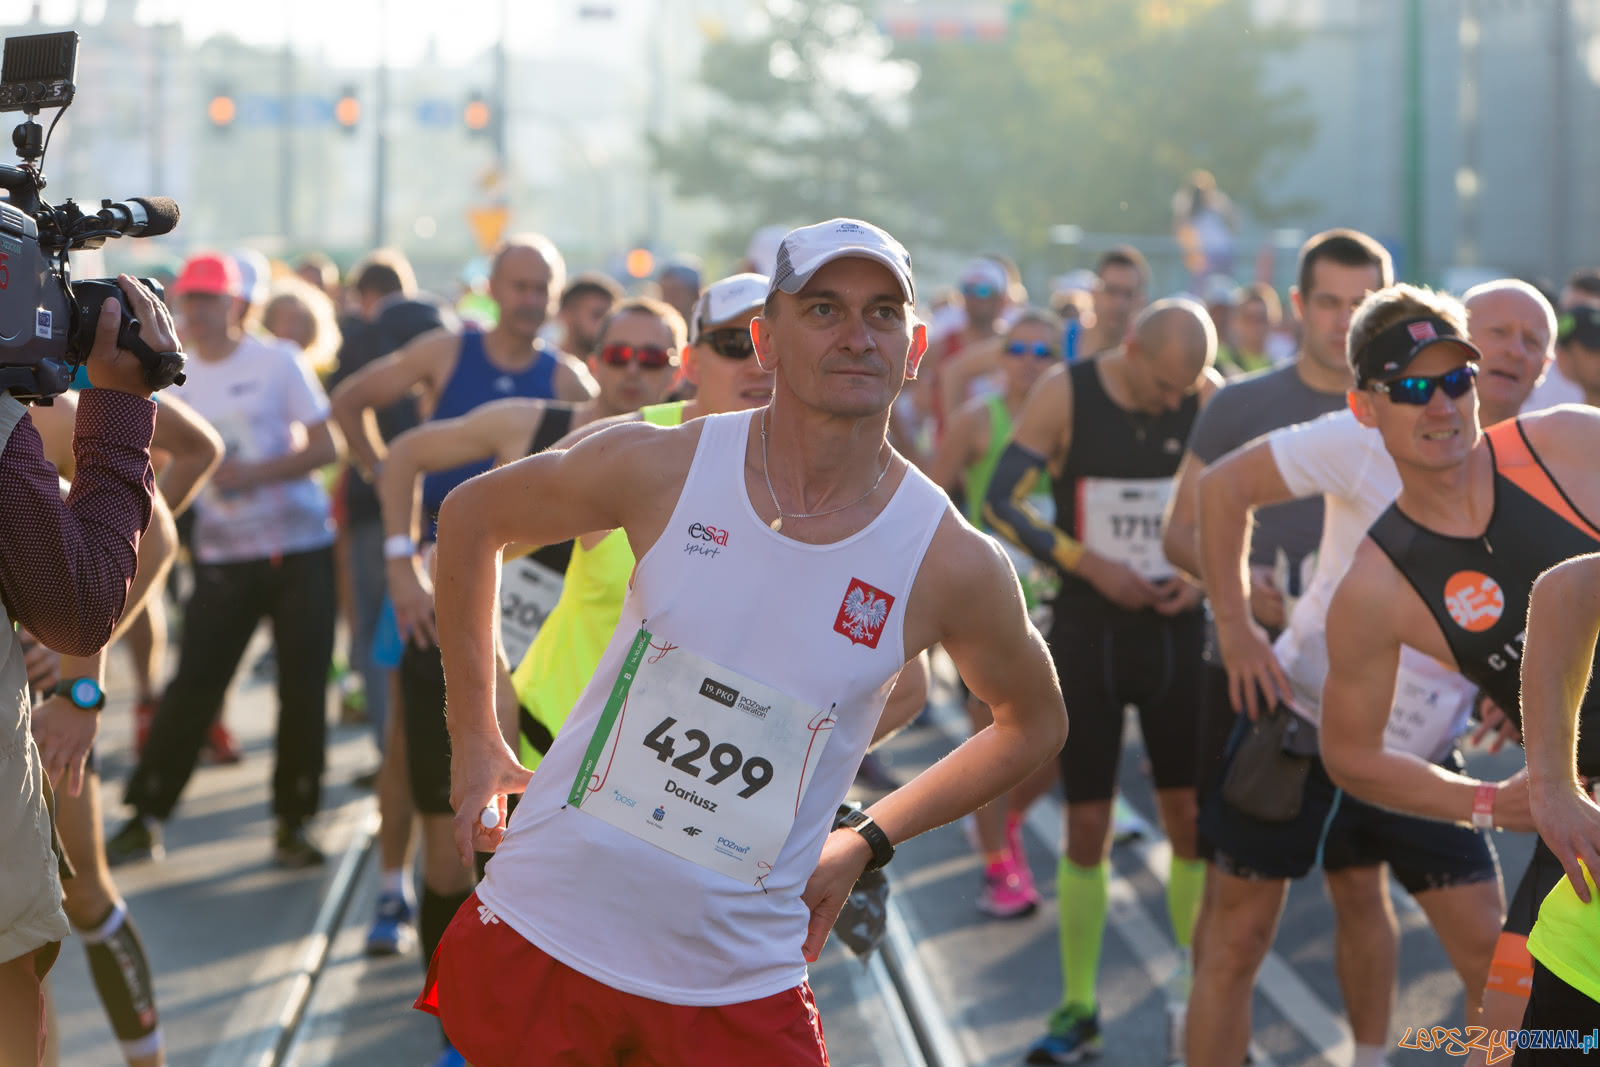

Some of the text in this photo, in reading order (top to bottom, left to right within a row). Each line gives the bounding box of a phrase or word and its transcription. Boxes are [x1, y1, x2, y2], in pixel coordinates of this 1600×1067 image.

[623, 672, 632, 681] B
[705, 683, 734, 702] 19. PKO
[737, 703, 767, 719] maraton
[642, 716, 774, 800] 4299
[664, 779, 719, 813] Dariusz
[682, 825, 703, 837] 4F
